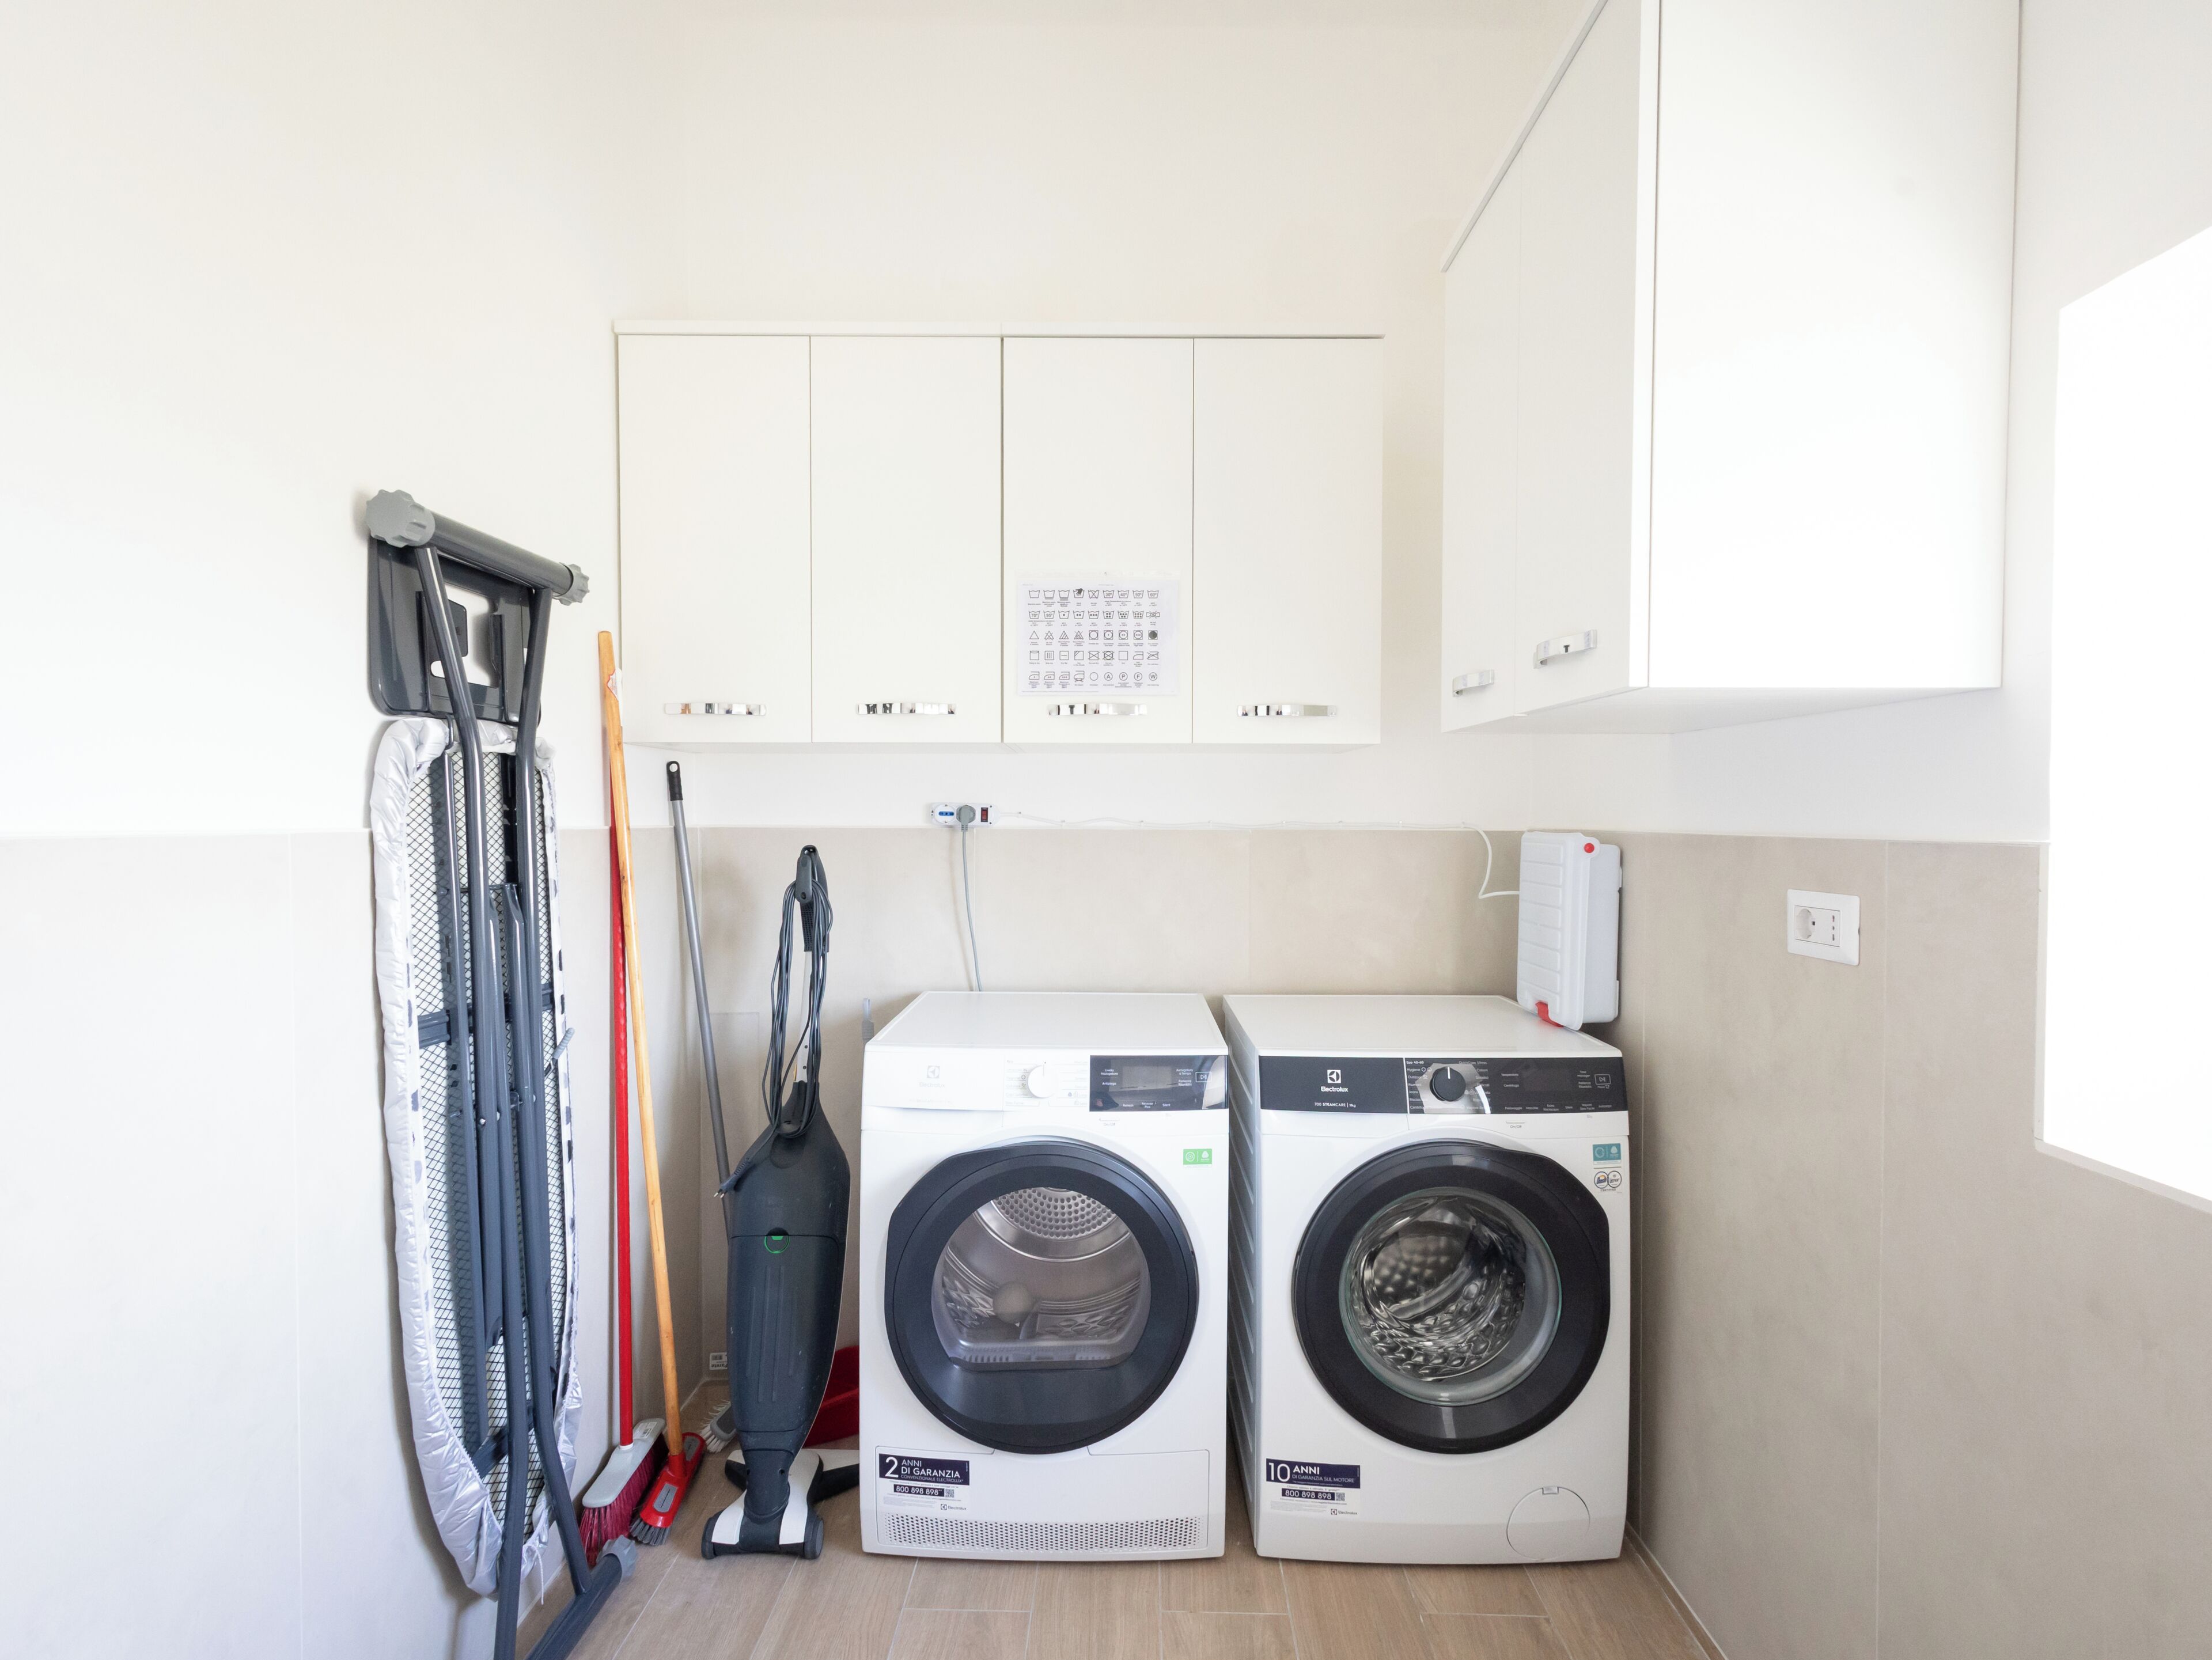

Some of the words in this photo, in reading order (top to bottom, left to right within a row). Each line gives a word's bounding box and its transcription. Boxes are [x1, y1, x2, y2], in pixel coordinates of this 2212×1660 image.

[885, 1456, 899, 1478] 2
[901, 1466, 910, 1475] DI
[913, 1468, 960, 1478] GARANZIA
[1268, 1462, 1290, 1482] 10
[1293, 1465, 1320, 1475] ANNI
